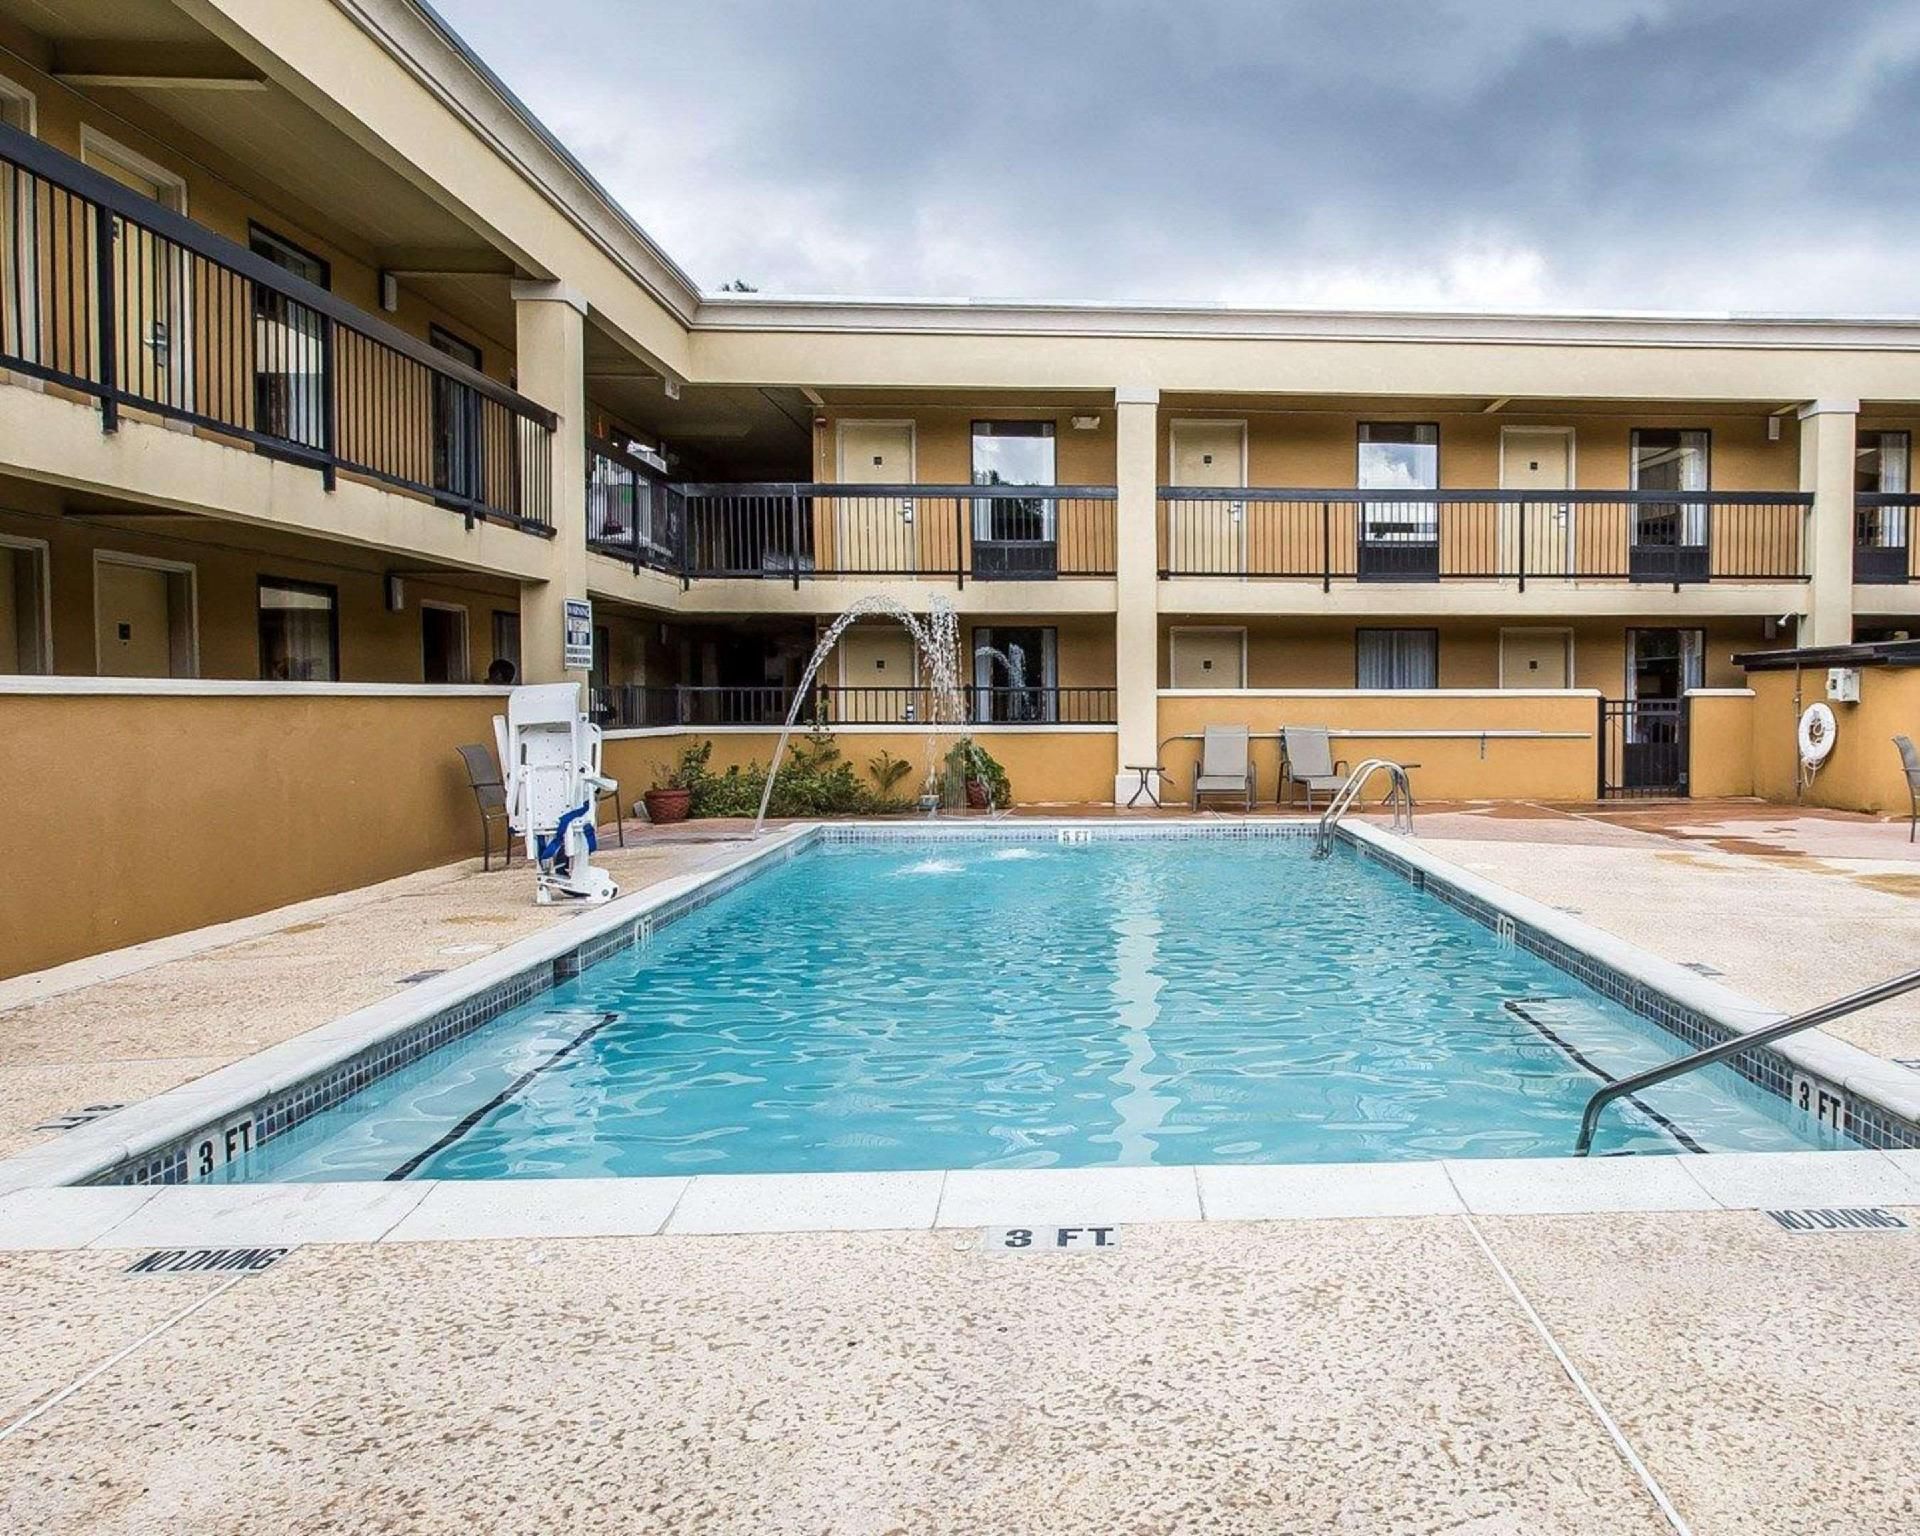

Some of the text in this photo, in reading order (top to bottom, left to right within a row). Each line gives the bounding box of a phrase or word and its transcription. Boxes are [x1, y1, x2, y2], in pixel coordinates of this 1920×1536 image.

[1799, 1081, 1810, 1112] 3
[199, 1140, 214, 1177] 3
[1766, 1208, 1909, 1230] NO DIVING
[1004, 1227, 1115, 1248] 3 FT.
[123, 1249, 288, 1273] NO DIVING
